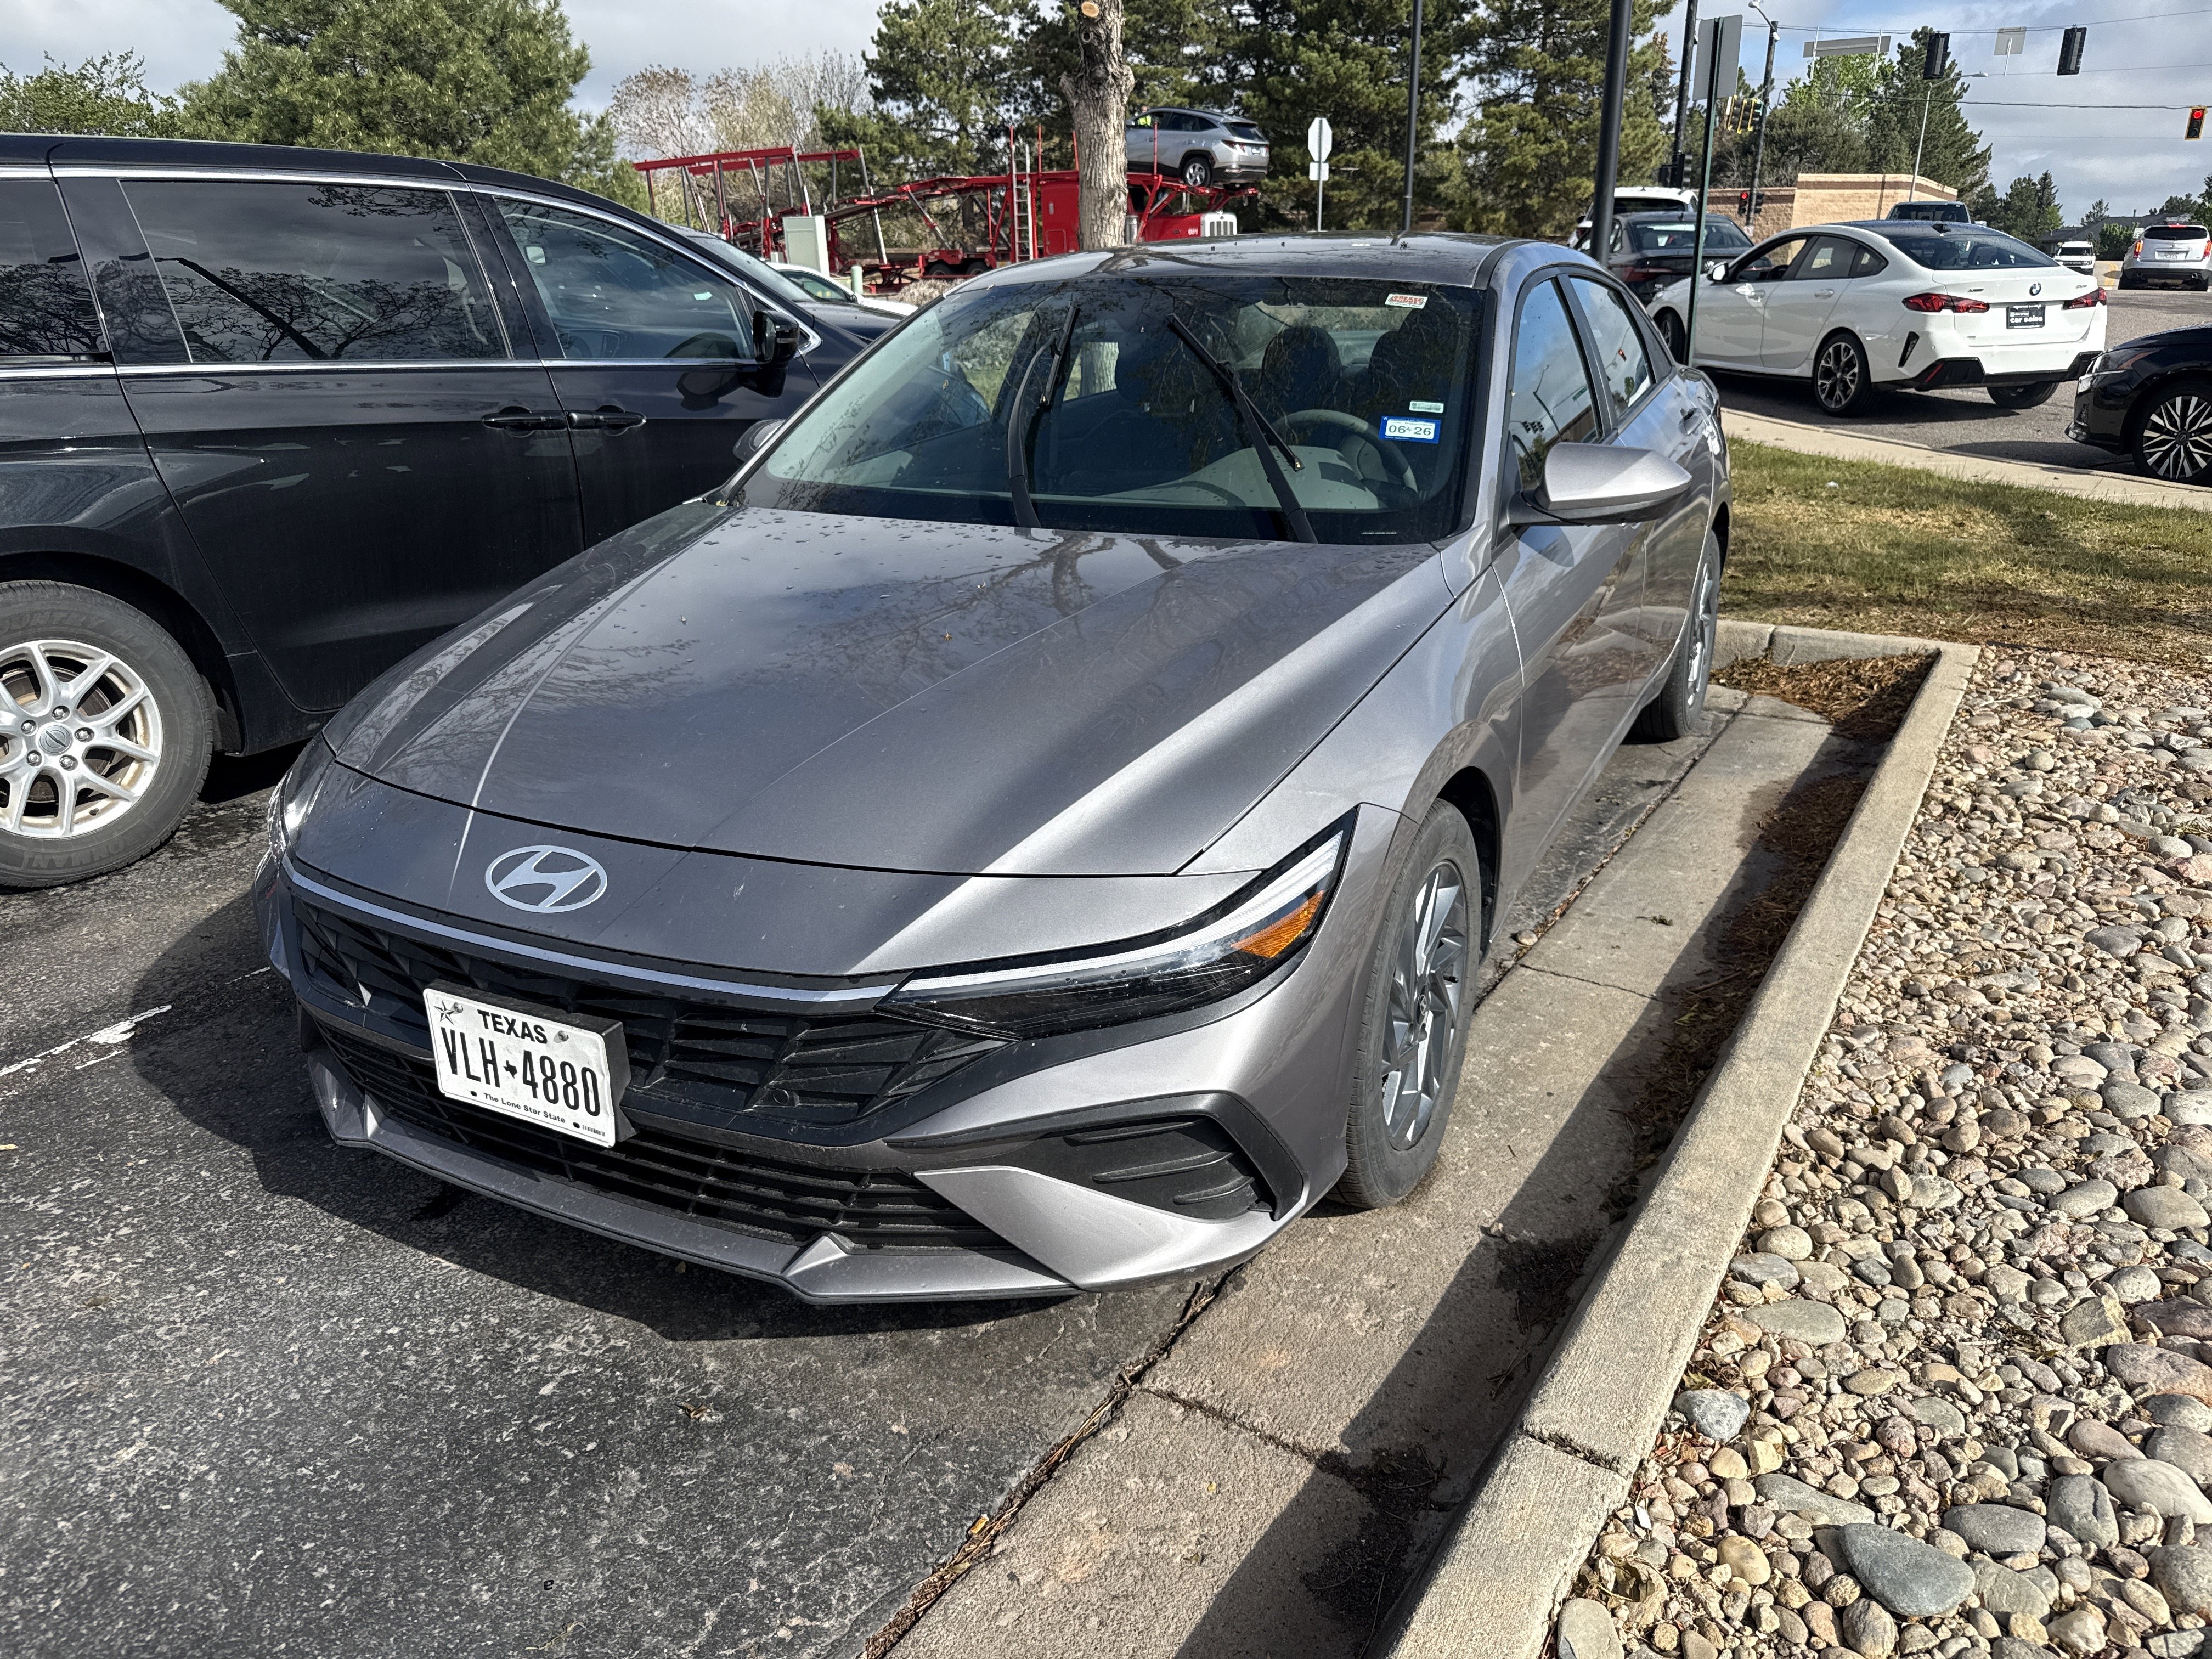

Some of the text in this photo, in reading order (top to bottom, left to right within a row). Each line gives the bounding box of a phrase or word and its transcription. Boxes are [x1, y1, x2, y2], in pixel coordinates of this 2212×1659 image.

[2023, 314, 2043, 323] sales
[1389, 425, 1431, 436] 06 26
[477, 1009, 548, 1044] TEXAS
[483, 1092, 566, 1124] The Lone Star State
